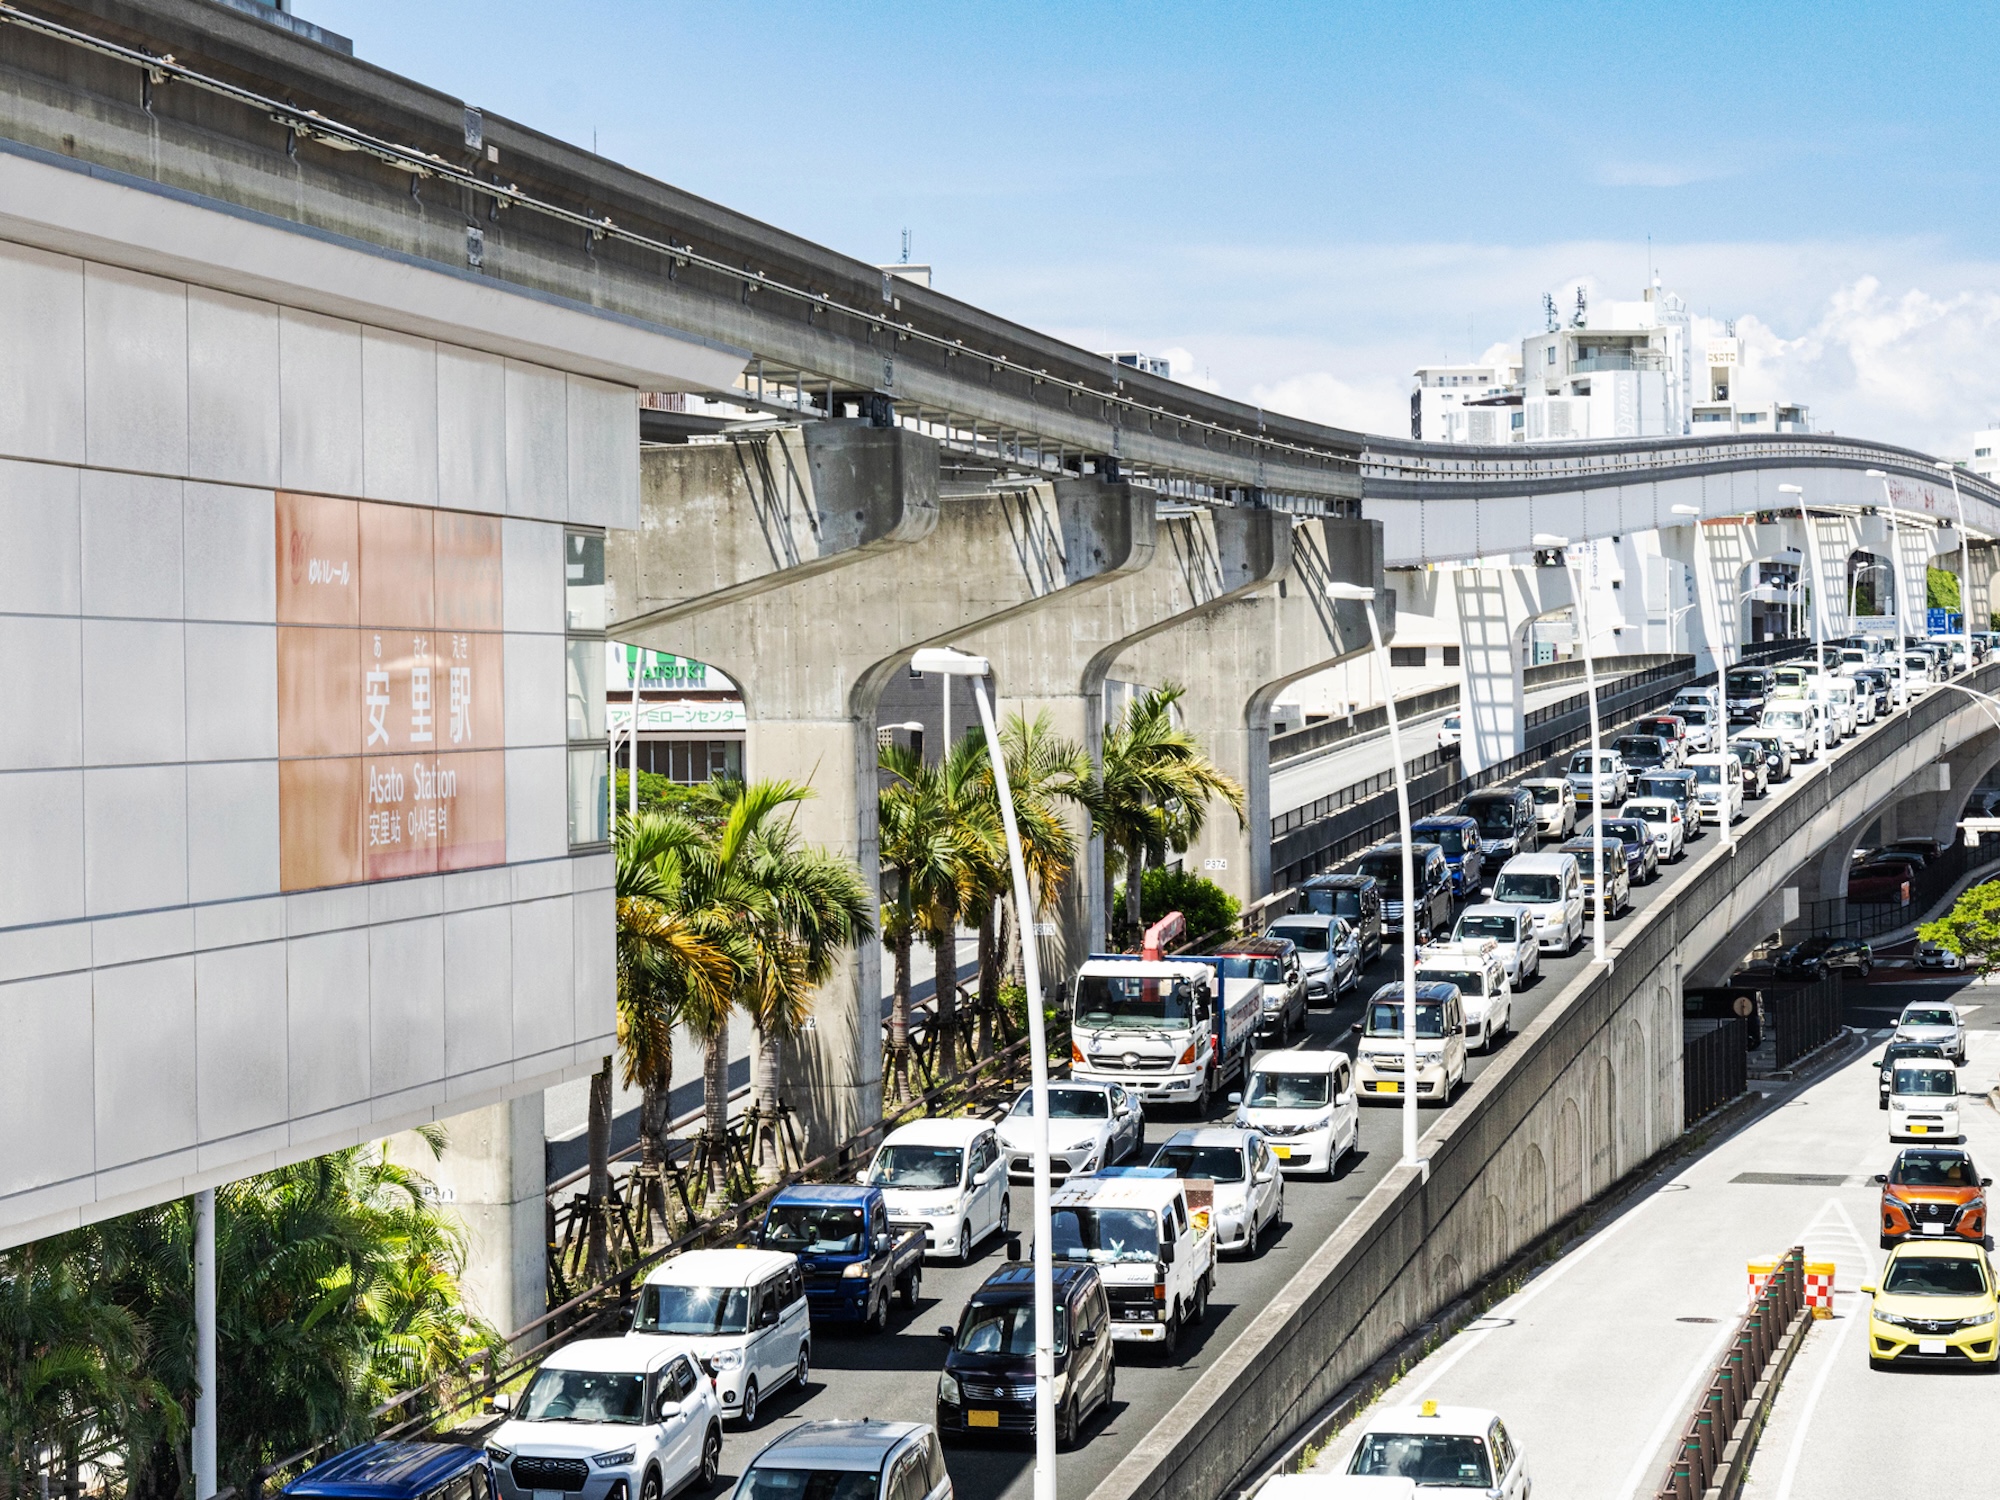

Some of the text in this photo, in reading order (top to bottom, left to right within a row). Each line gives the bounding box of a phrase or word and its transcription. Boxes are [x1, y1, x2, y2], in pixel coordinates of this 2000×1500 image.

[308, 558, 350, 586] ゆいレール
[366, 663, 472, 747] 安里駅
[368, 758, 457, 804] Asato Station
[369, 810, 401, 846] 安里站
[407, 804, 447, 842] 아사토역
[1205, 860, 1226, 869] P374
